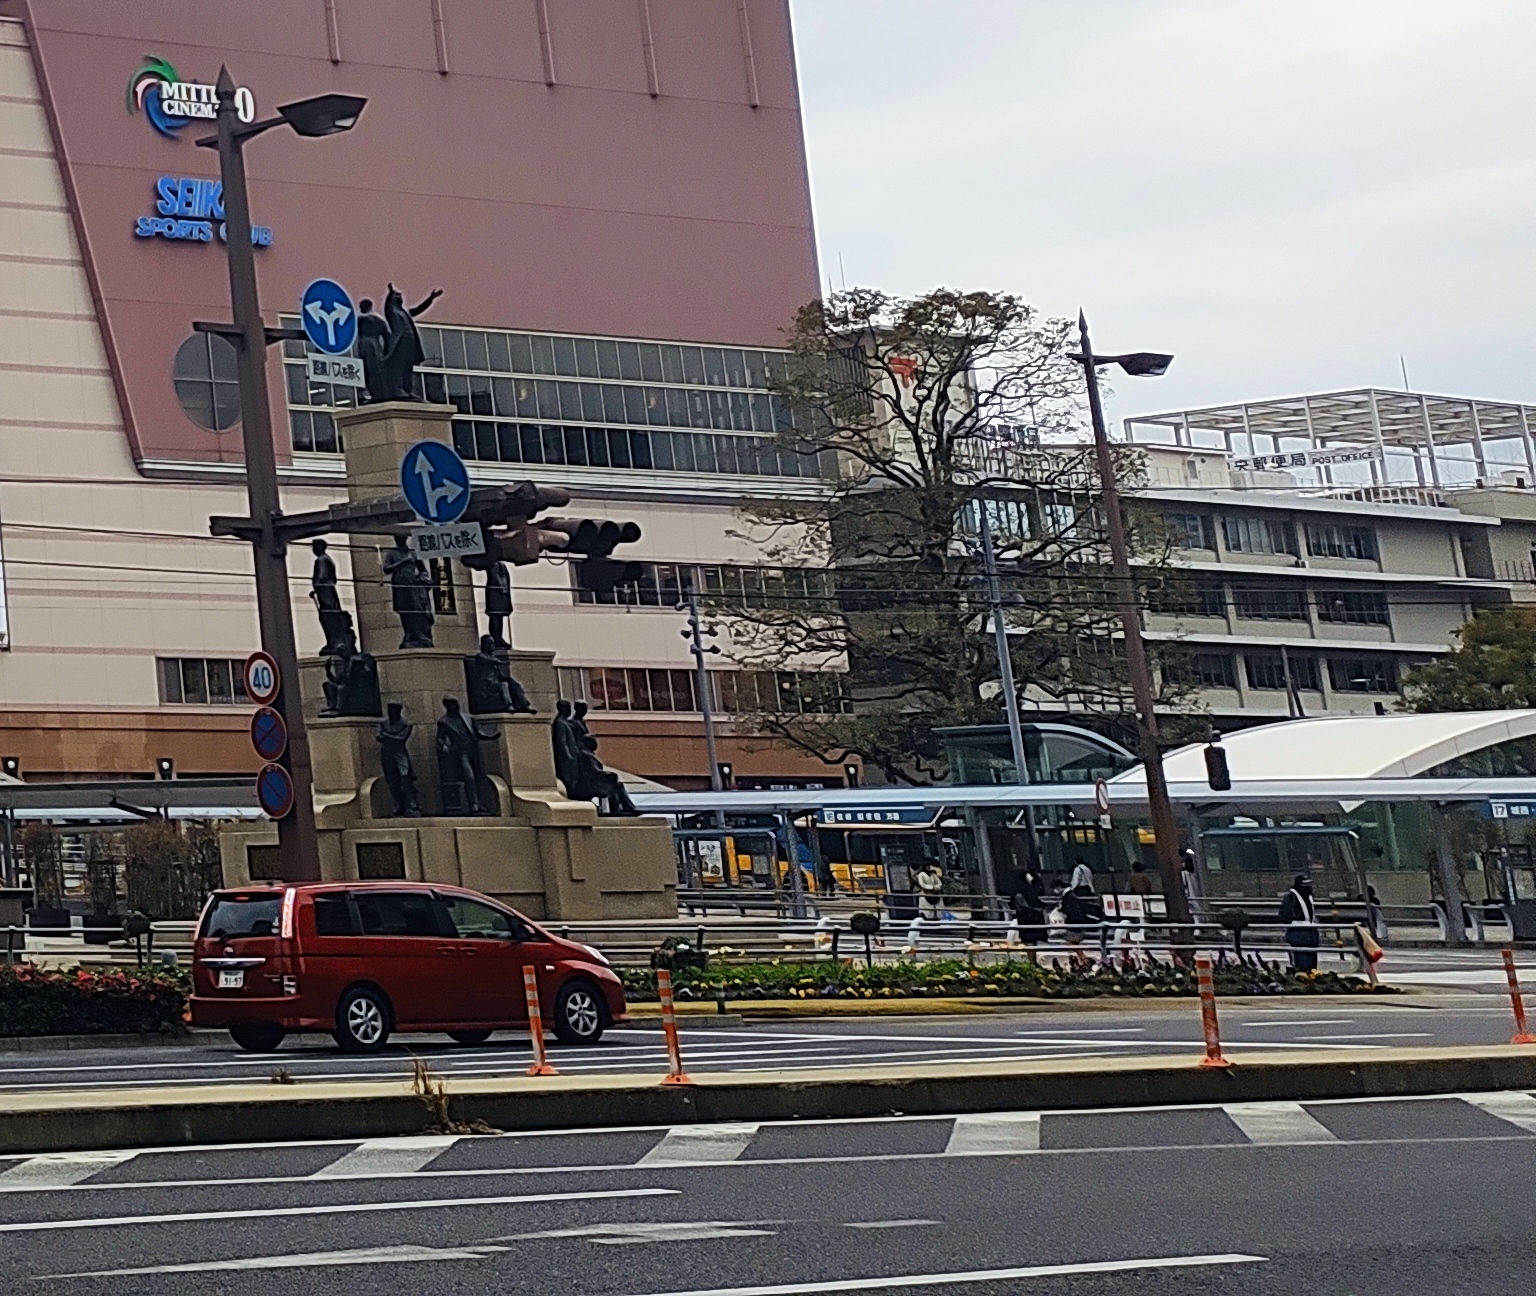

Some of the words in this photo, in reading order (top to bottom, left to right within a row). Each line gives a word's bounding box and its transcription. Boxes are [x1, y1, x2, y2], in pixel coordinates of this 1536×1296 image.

[162, 100, 221, 119] CINEM
[156, 175, 227, 220] SEIK
[135, 216, 213, 242] SPORTS
[1311, 455, 1336, 465] POST
[1341, 451, 1374, 462] OFFICE
[253, 666, 272, 690] 40
